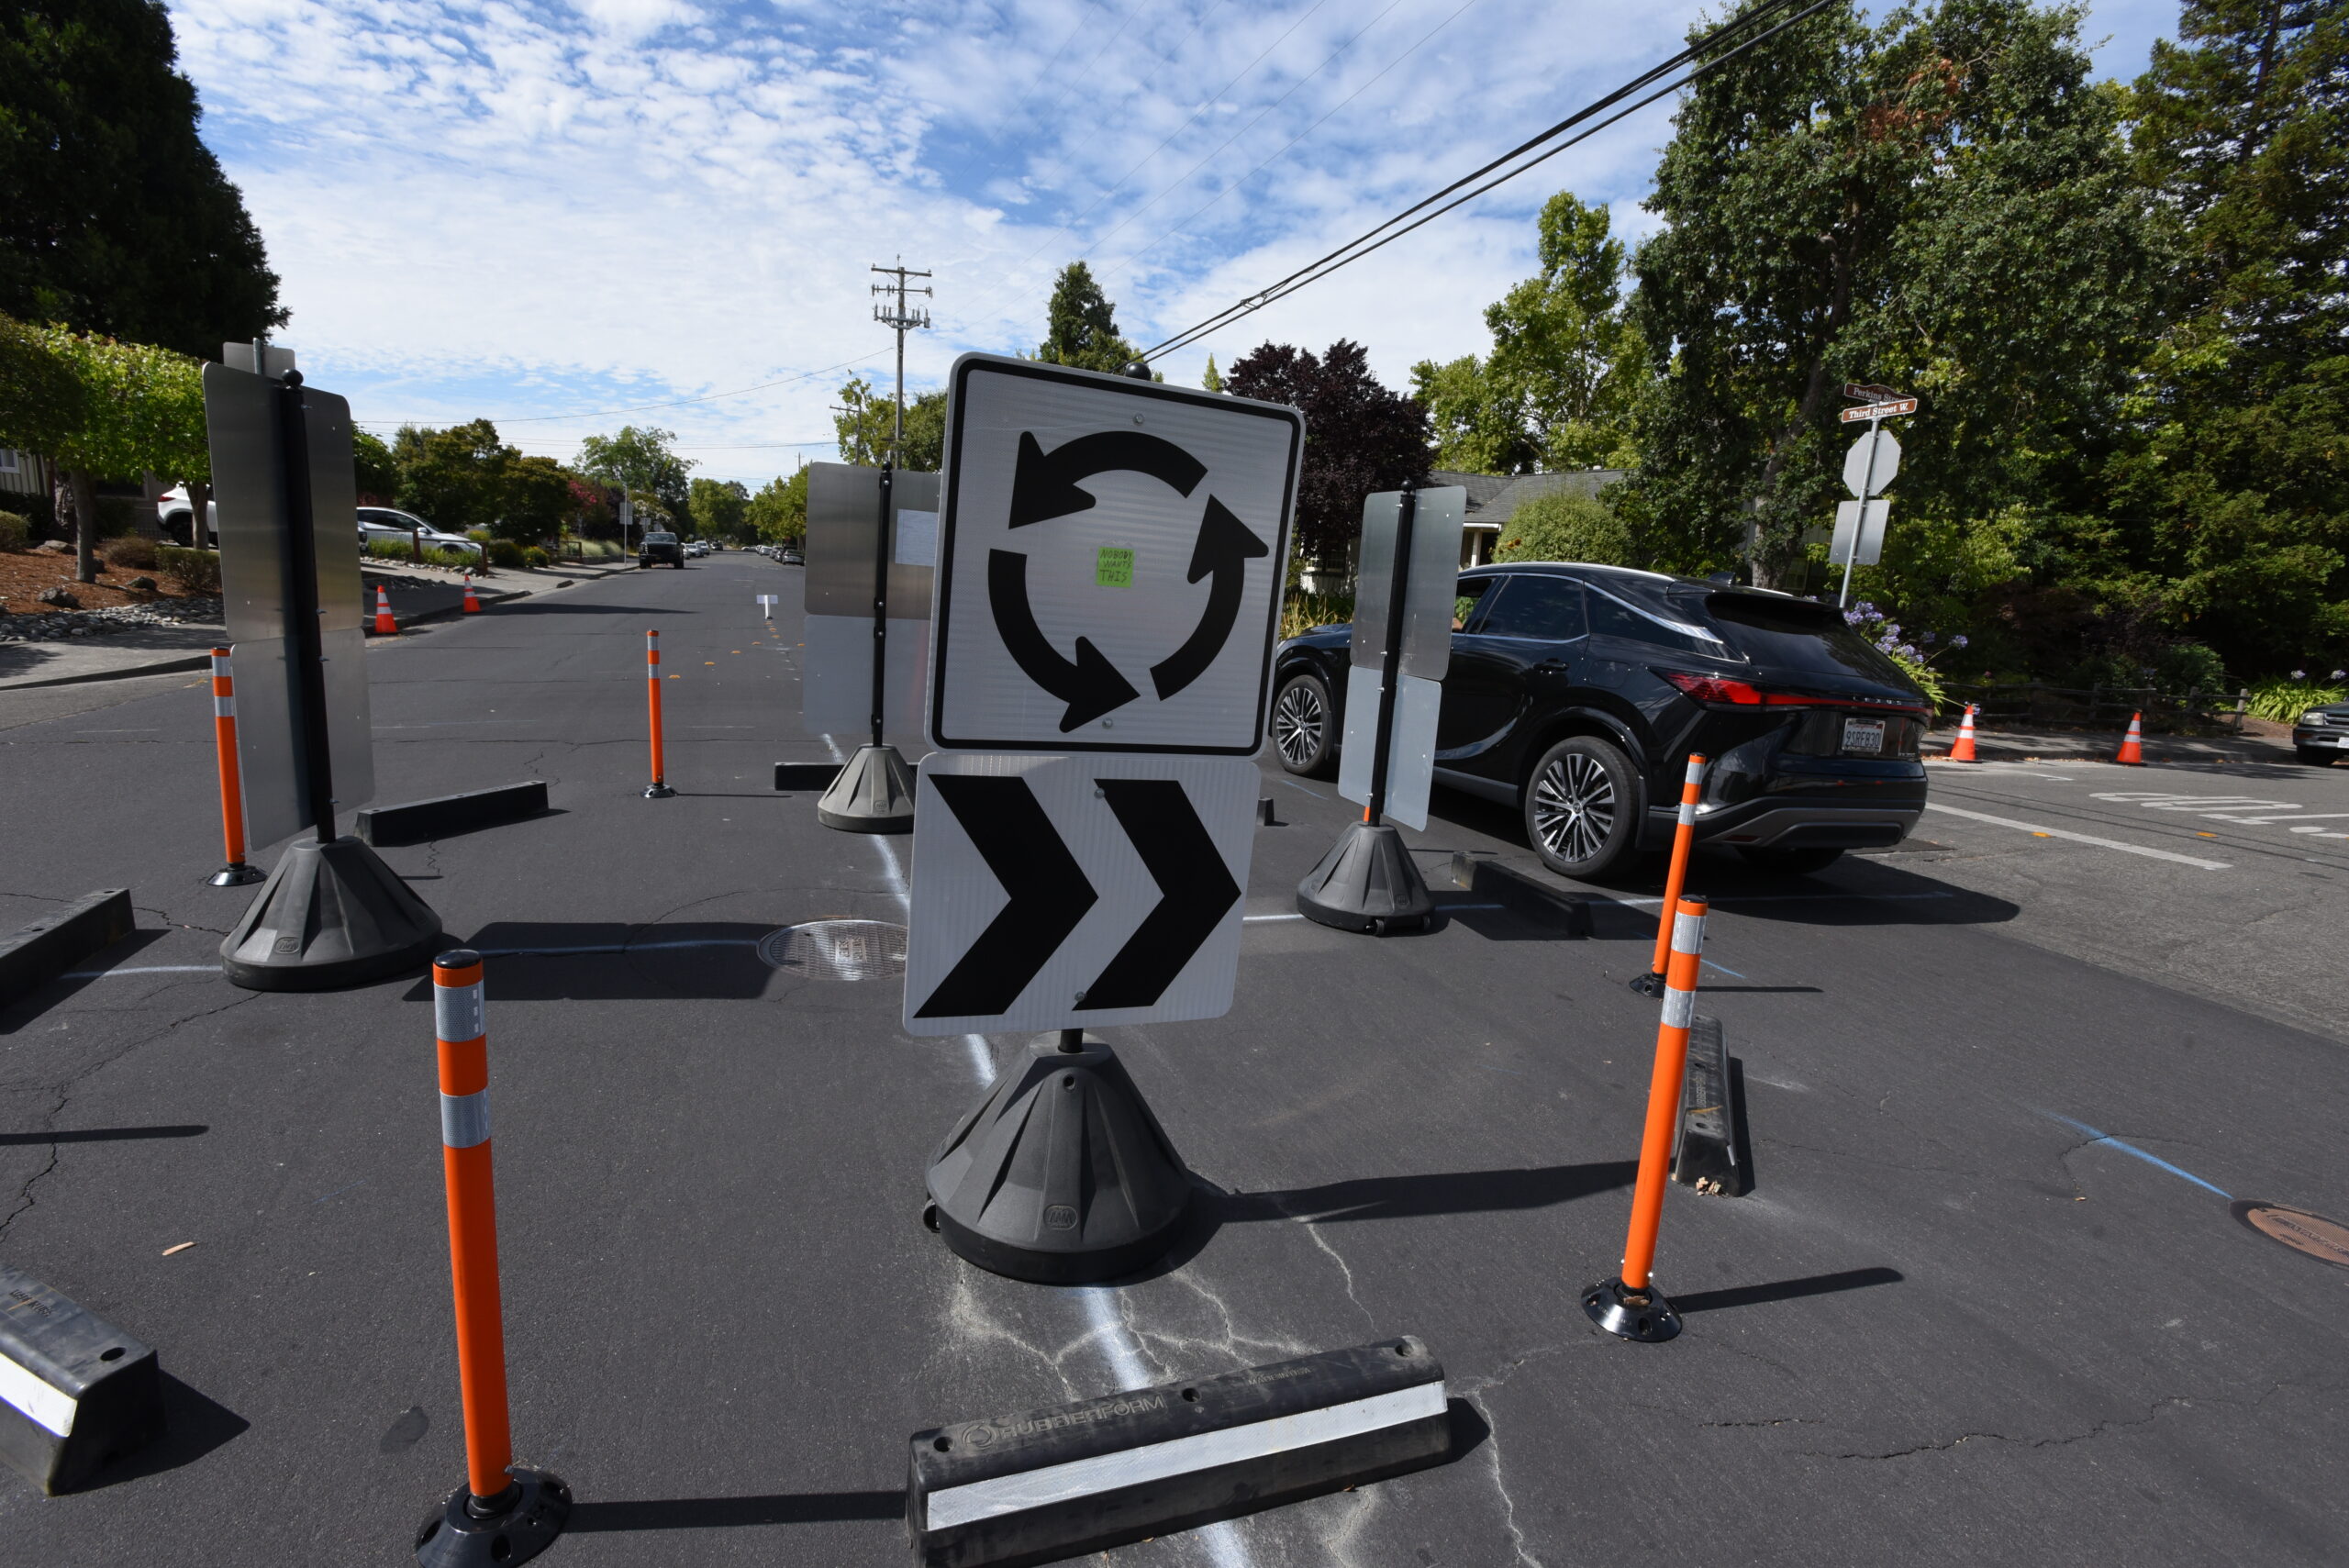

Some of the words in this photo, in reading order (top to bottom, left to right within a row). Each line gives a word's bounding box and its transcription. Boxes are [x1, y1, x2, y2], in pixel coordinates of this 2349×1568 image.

[1854, 387, 1882, 401] Perkins
[1849, 408, 1871, 419] Third
[1873, 405, 1897, 416] Street
[1899, 403, 1909, 412] W.
[1100, 550, 1131, 560] NOBODY
[1099, 569, 1128, 583] THIS
[1000, 1394, 1167, 1440] RUBBERFORM
